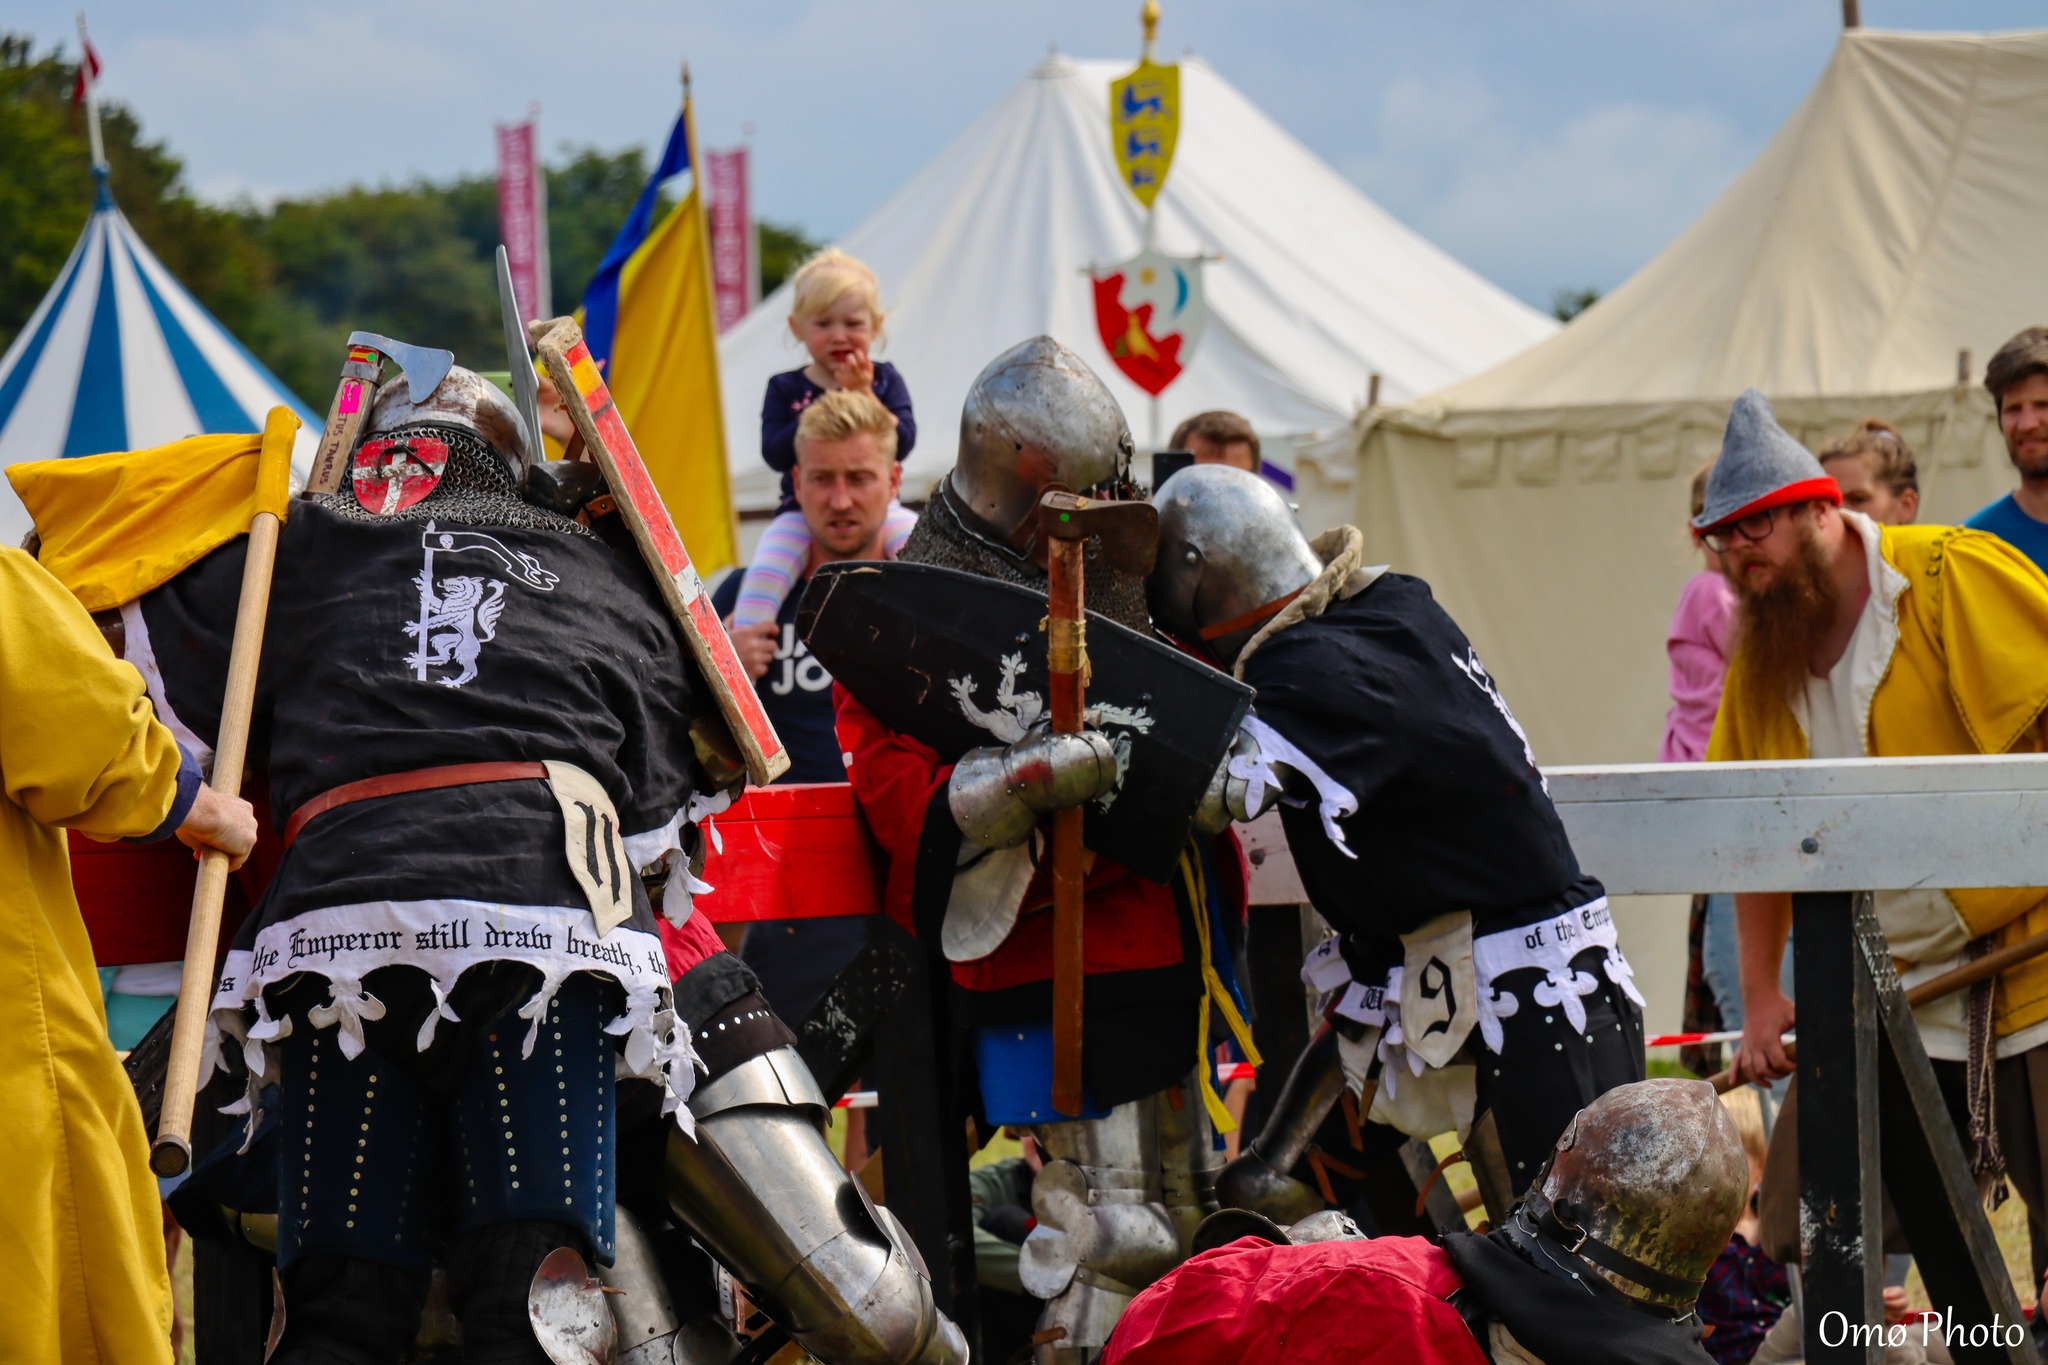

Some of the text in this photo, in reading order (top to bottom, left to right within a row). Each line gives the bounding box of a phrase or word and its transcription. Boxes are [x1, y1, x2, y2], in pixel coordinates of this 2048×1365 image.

[251, 945, 279, 977] the
[287, 927, 403, 969] Emperor
[415, 918, 472, 950] still
[483, 921, 552, 949] draw
[565, 925, 642, 975] breath,
[1524, 926, 1546, 949] of
[1555, 919, 1576, 943] the
[1419, 955, 1457, 1041] 9
